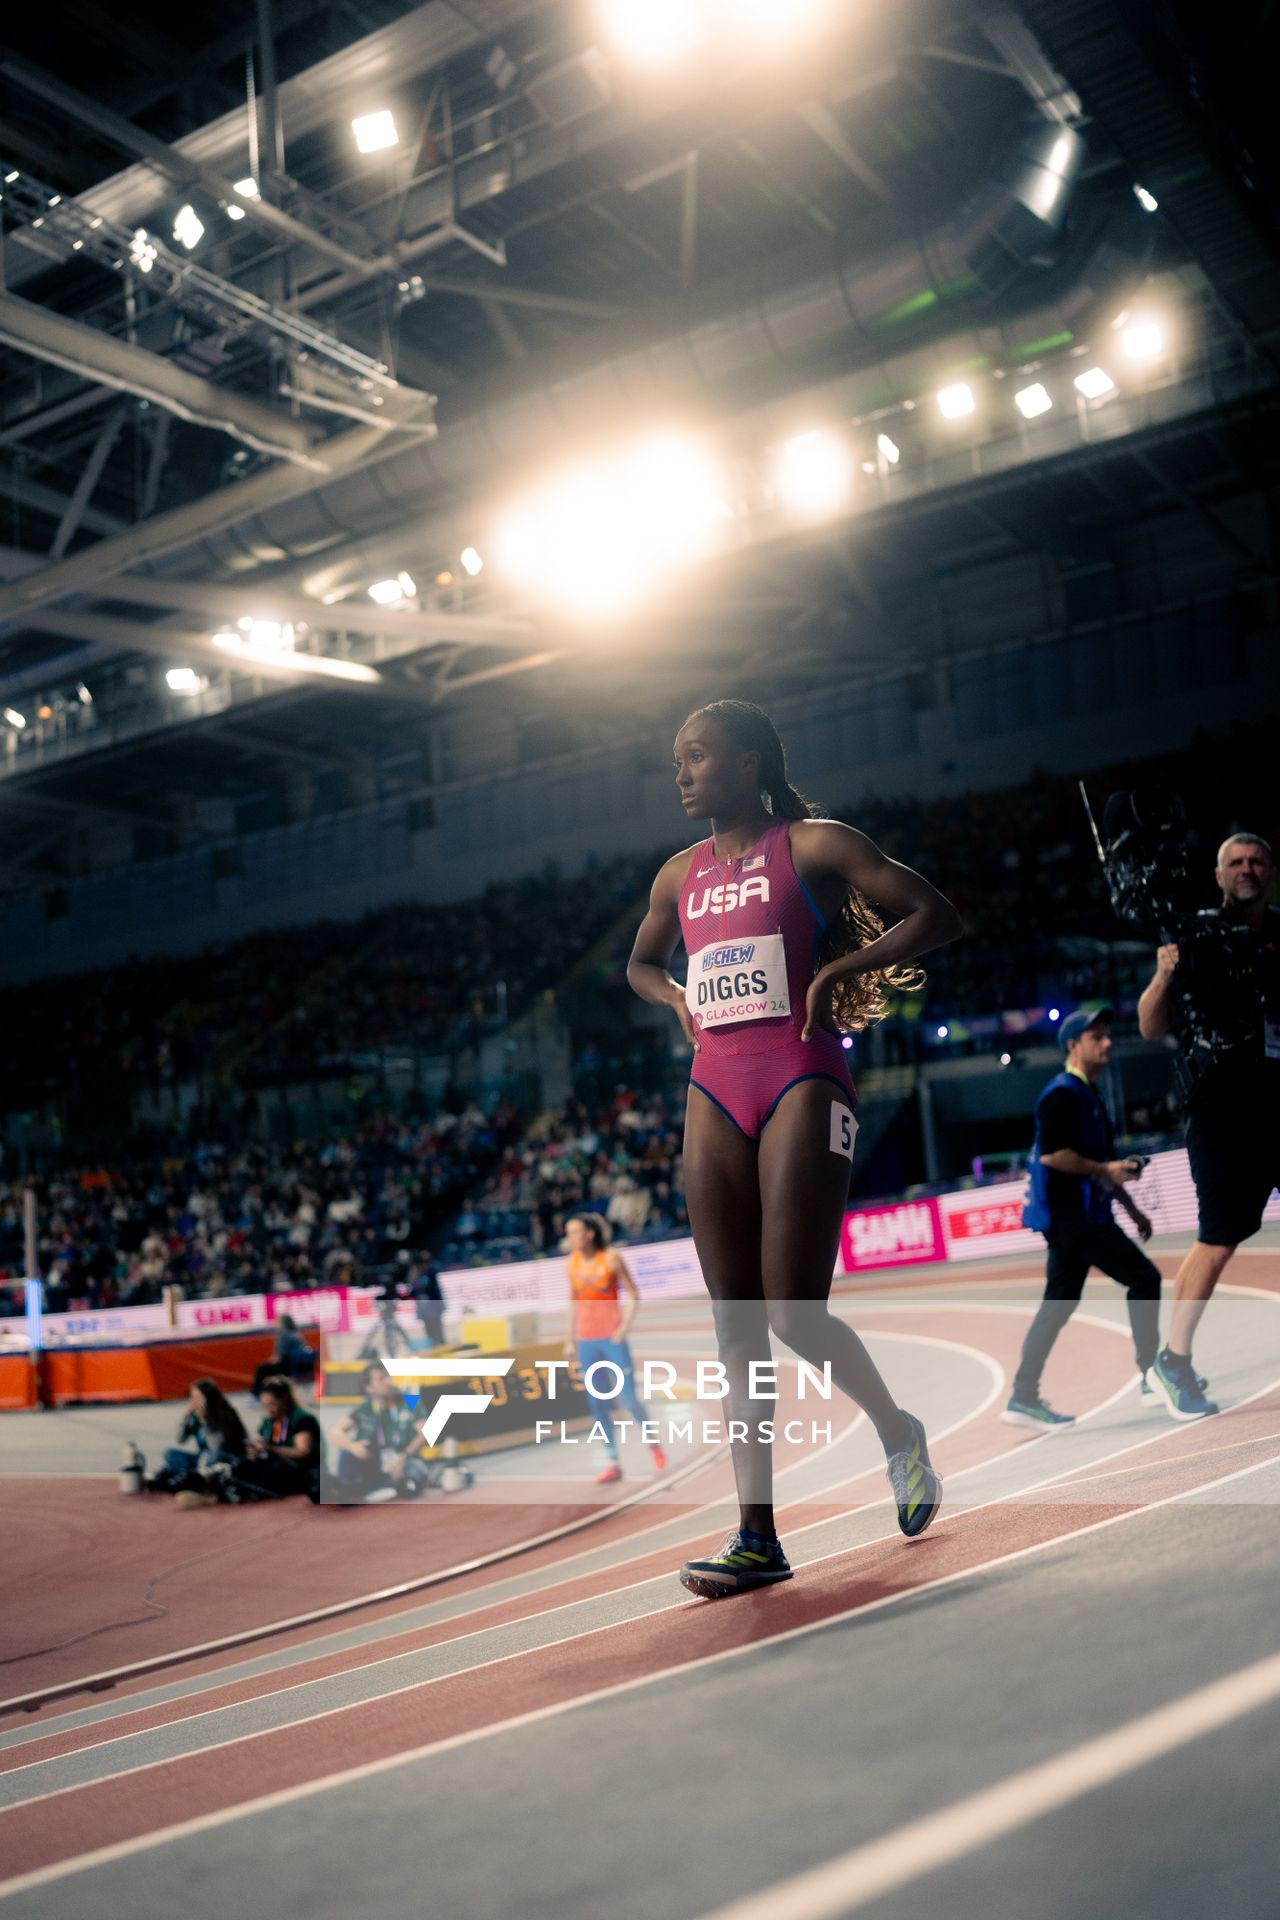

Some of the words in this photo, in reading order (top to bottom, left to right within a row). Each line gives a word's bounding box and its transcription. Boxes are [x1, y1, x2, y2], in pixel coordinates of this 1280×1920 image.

[687, 876, 769, 920] USA
[703, 945, 755, 971] HI-CHEW
[697, 969, 768, 1006] DIGGS
[706, 1001, 768, 1023] GLASGOW
[771, 1000, 787, 1012] 24
[841, 1115, 852, 1151] 5
